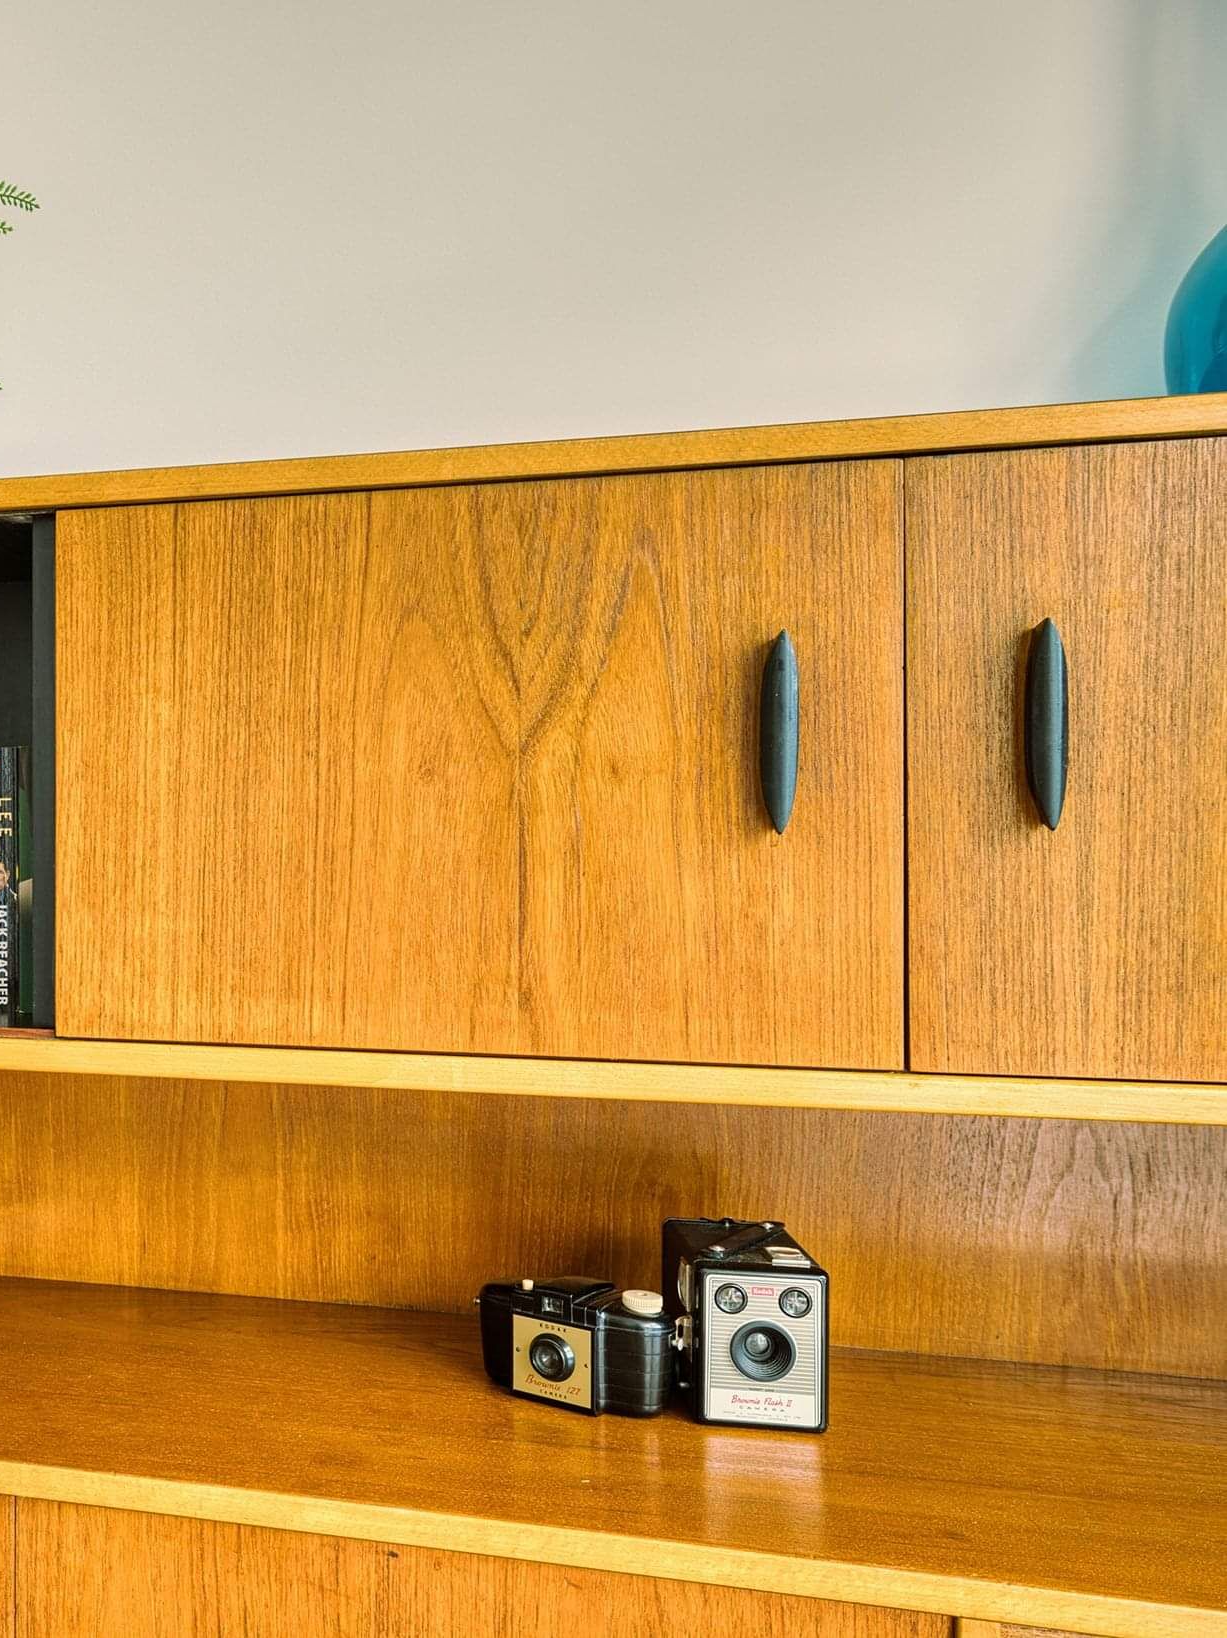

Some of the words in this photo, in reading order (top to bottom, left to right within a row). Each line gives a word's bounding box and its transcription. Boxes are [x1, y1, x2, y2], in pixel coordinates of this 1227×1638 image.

[525, 1374, 561, 1391] Brownie
[731, 1394, 761, 1405] Brownie
[764, 1397, 783, 1407] Flash
